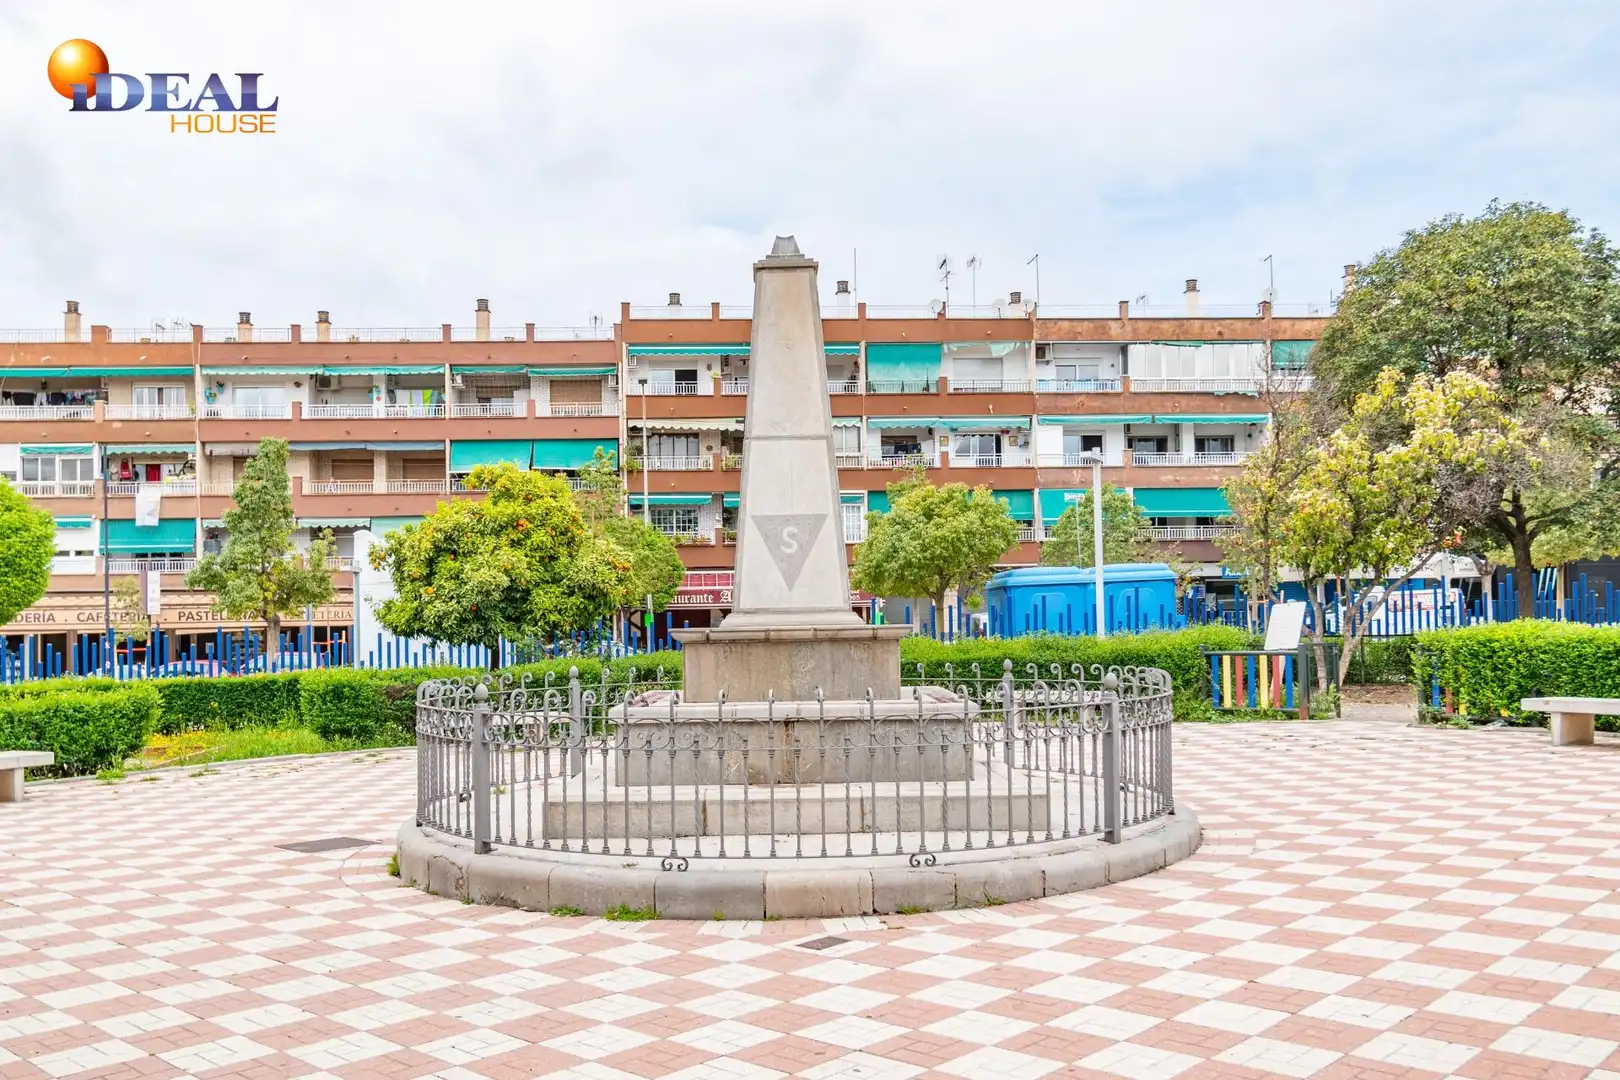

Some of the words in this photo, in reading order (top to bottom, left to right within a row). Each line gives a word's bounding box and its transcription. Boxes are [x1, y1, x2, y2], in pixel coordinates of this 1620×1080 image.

[781, 526, 798, 553] S
[671, 593, 714, 604] aurante
[719, 590, 732, 603] A
[13, 609, 56, 623] DERÍA
